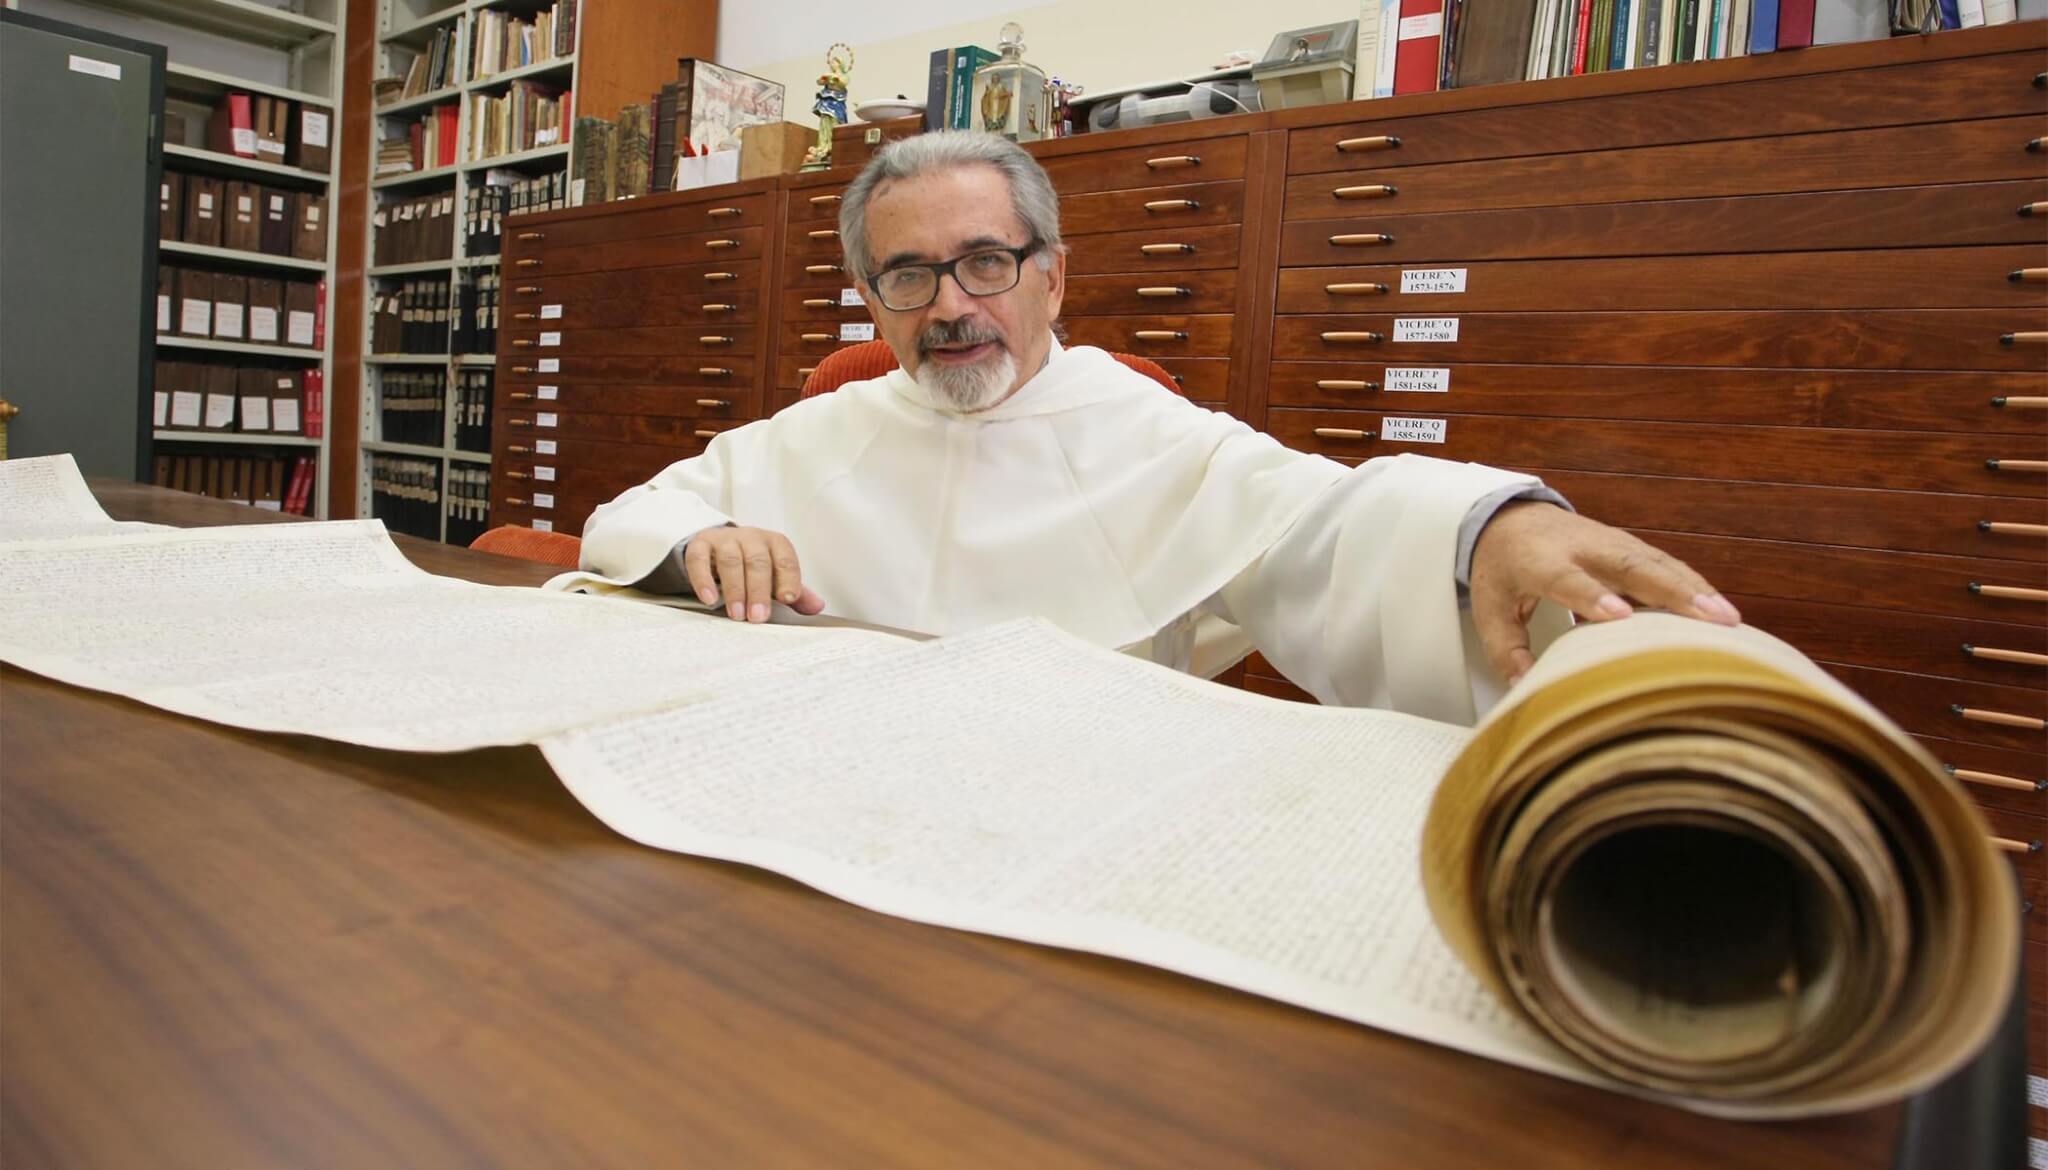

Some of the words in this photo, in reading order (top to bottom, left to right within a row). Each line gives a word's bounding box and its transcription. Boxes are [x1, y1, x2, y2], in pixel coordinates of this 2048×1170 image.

[1410, 282, 1455, 291] 1573-1576
[1444, 320, 1452, 328] O
[1405, 331, 1450, 340] 1577-1580
[1432, 371, 1439, 379] P
[1394, 381, 1437, 390] 1581-1584
[1431, 421, 1440, 430] Q
[1393, 431, 1437, 440] 1585-1591
